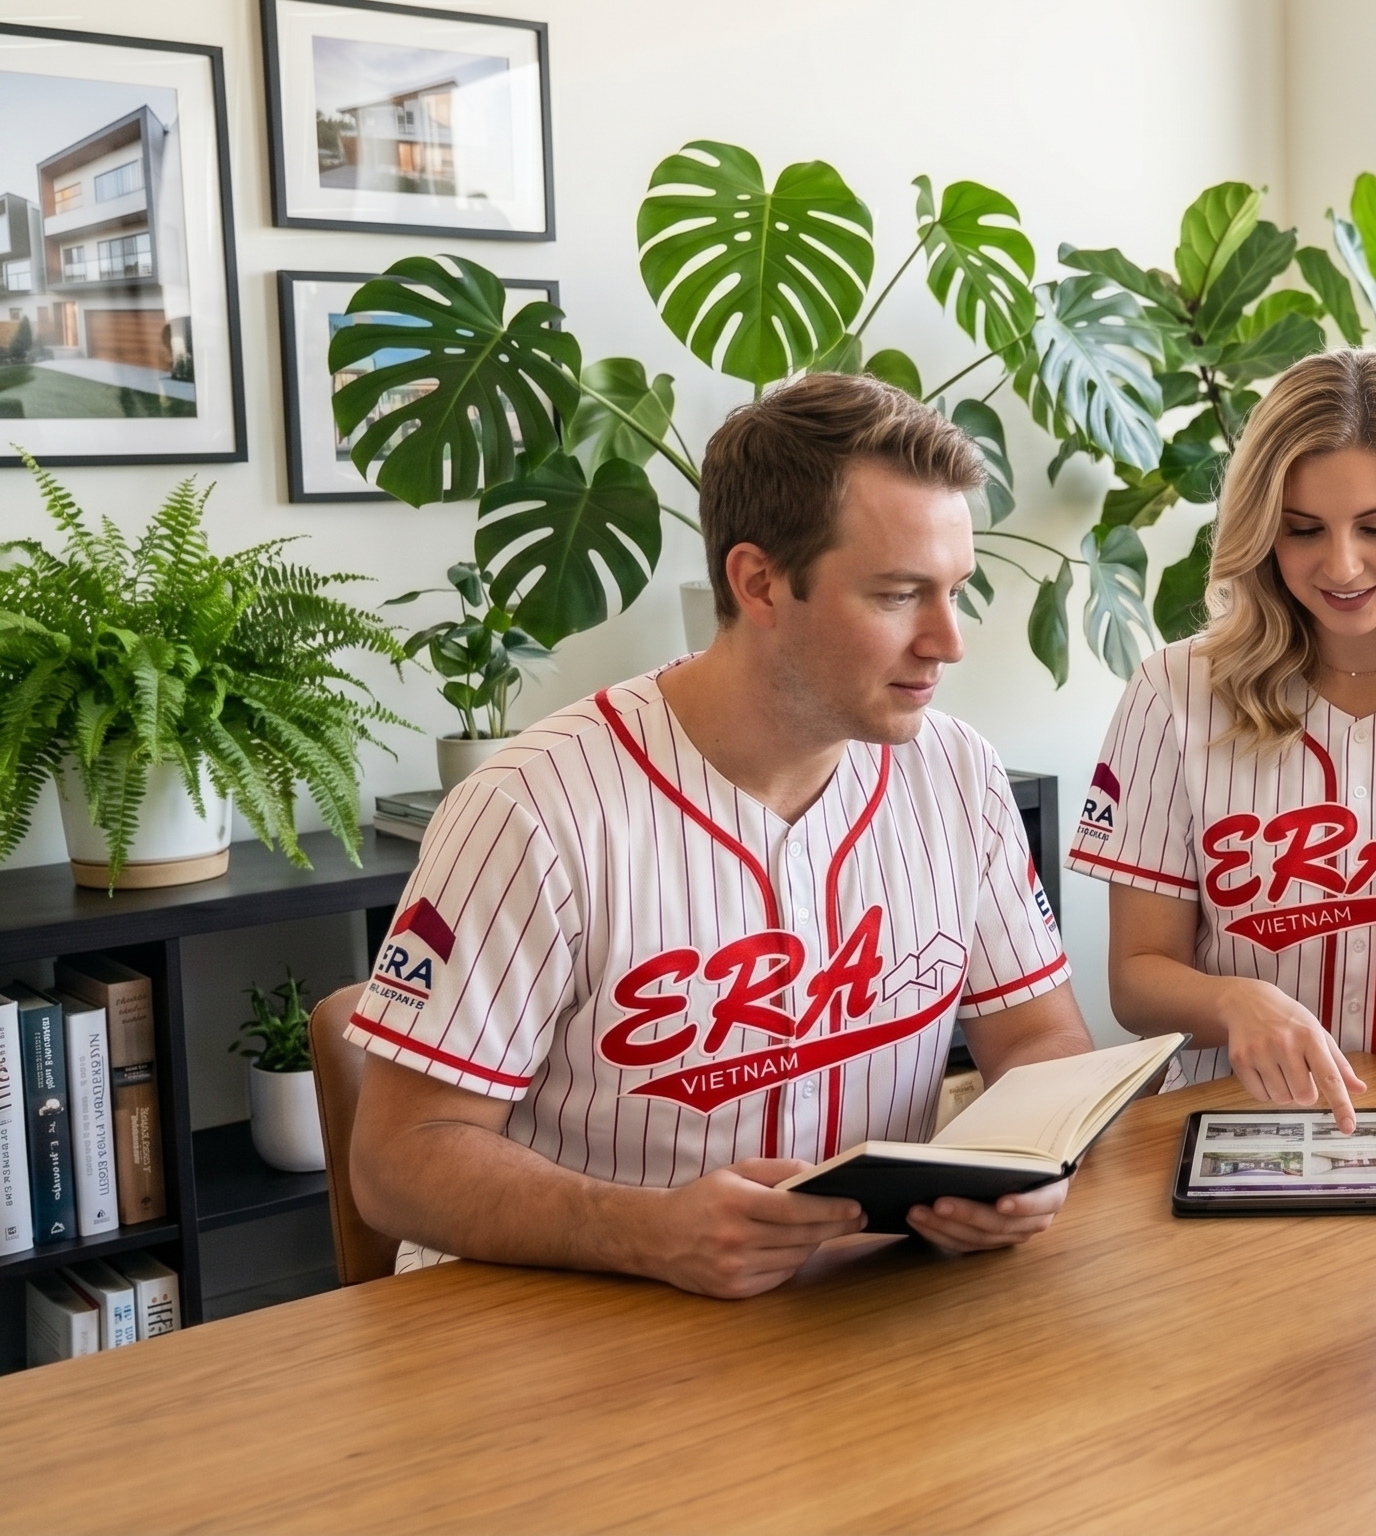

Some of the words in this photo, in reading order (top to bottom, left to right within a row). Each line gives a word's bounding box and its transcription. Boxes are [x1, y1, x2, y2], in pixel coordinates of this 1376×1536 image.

[1081, 798, 1114, 828] RA
[1252, 906, 1351, 935] VIETNAM
[598, 905, 884, 1068] ERA
[681, 1053, 798, 1094] VIETNAM
